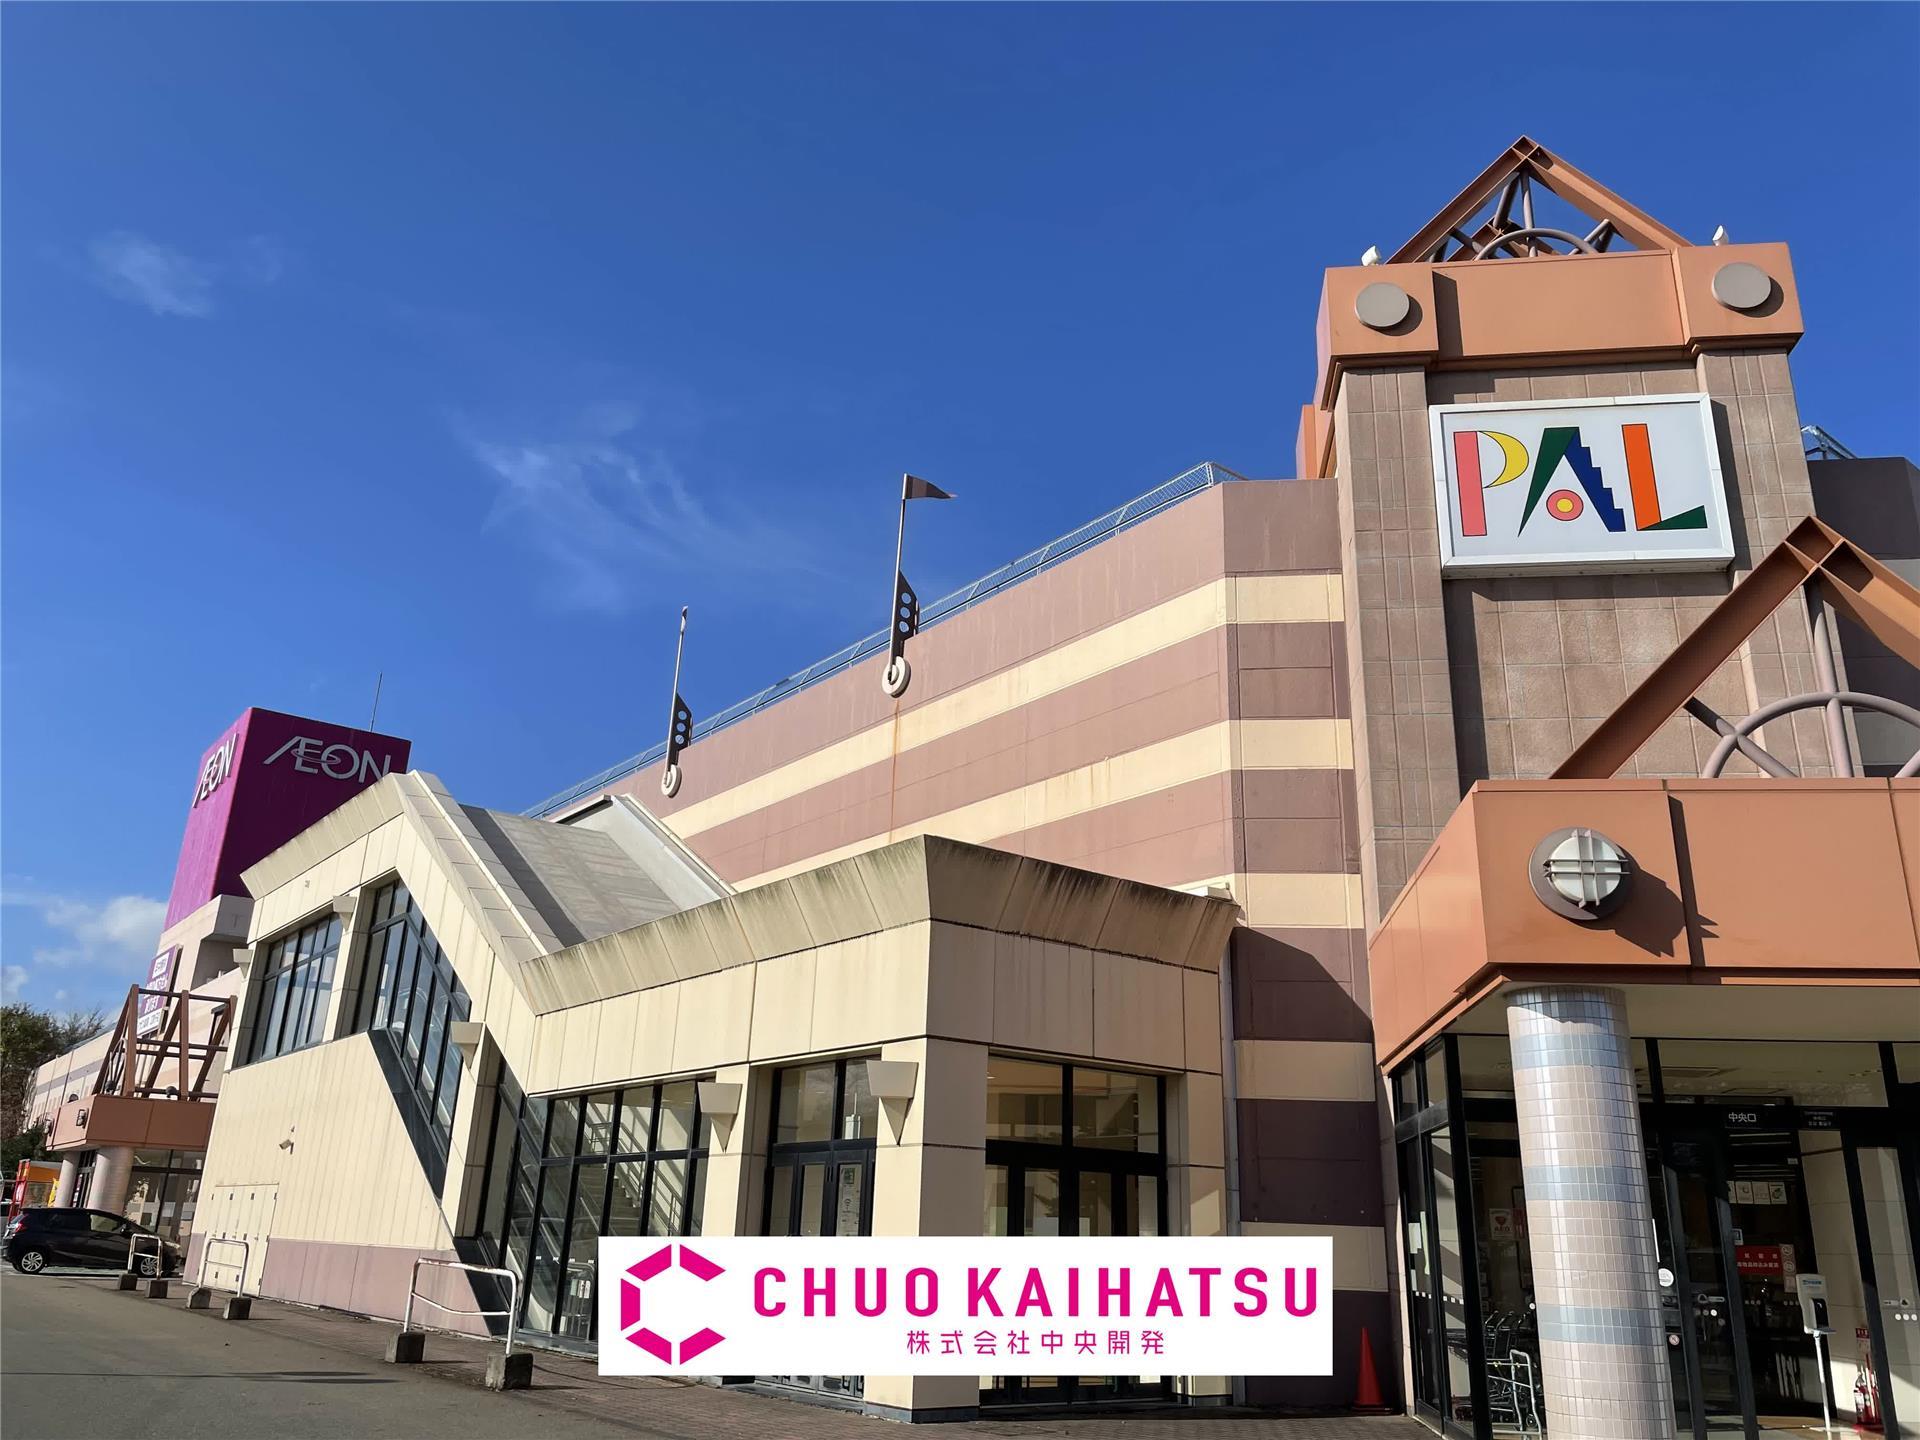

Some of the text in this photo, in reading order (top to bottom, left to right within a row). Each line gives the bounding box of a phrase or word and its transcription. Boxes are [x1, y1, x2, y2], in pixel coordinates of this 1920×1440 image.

[1453, 423, 1708, 538] PAL
[1727, 1111, 1758, 1123] 中央口
